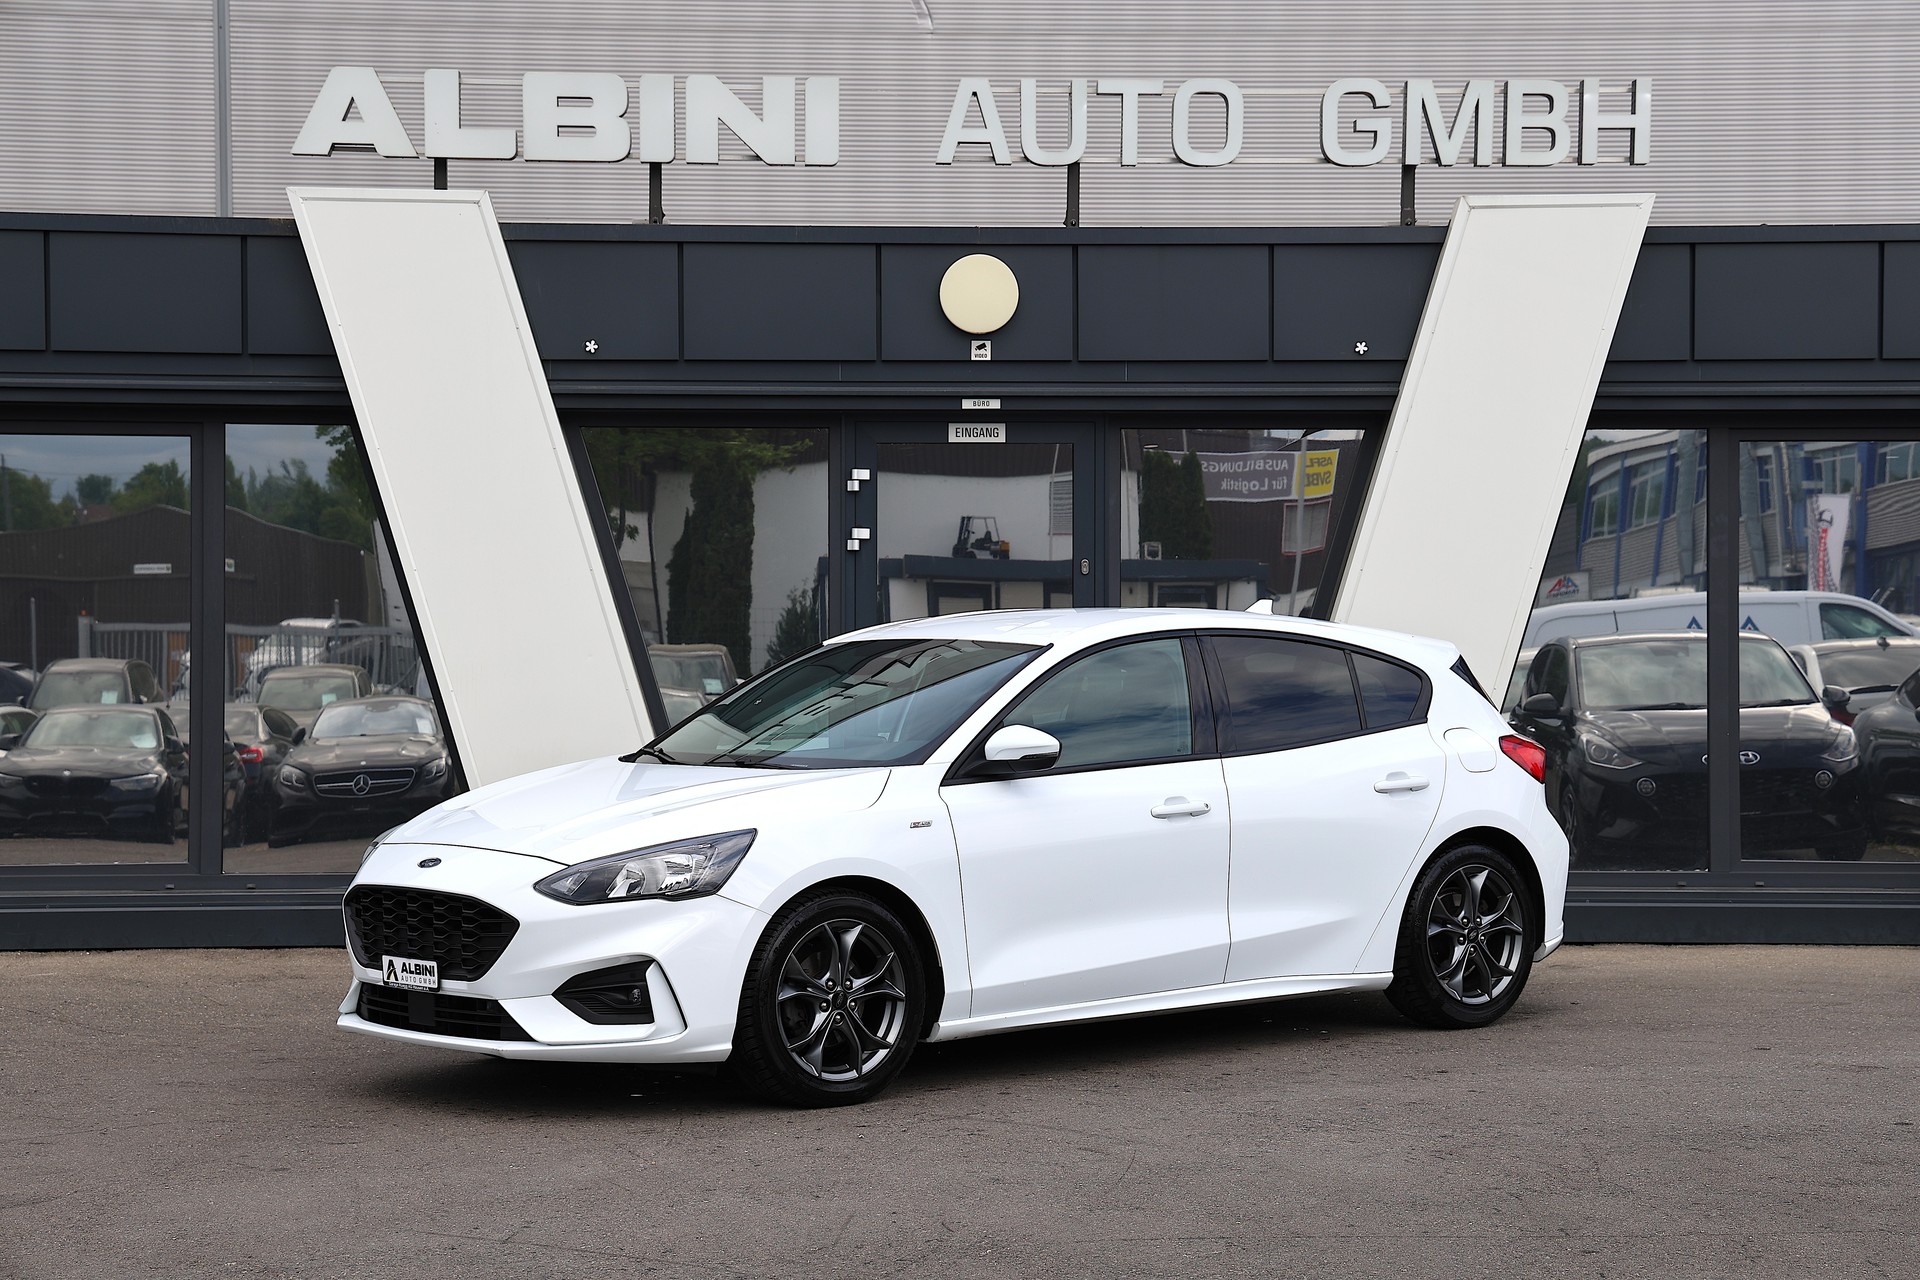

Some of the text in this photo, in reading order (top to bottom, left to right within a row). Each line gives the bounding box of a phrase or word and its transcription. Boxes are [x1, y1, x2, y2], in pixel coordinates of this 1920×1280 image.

[291, 66, 1653, 168] ALBINI AUTO GMBH
[972, 399, 990, 407] BÜRO
[955, 427, 1000, 438] EINGANG
[401, 961, 435, 977] ALBINI
[401, 975, 417, 984] AUTO
